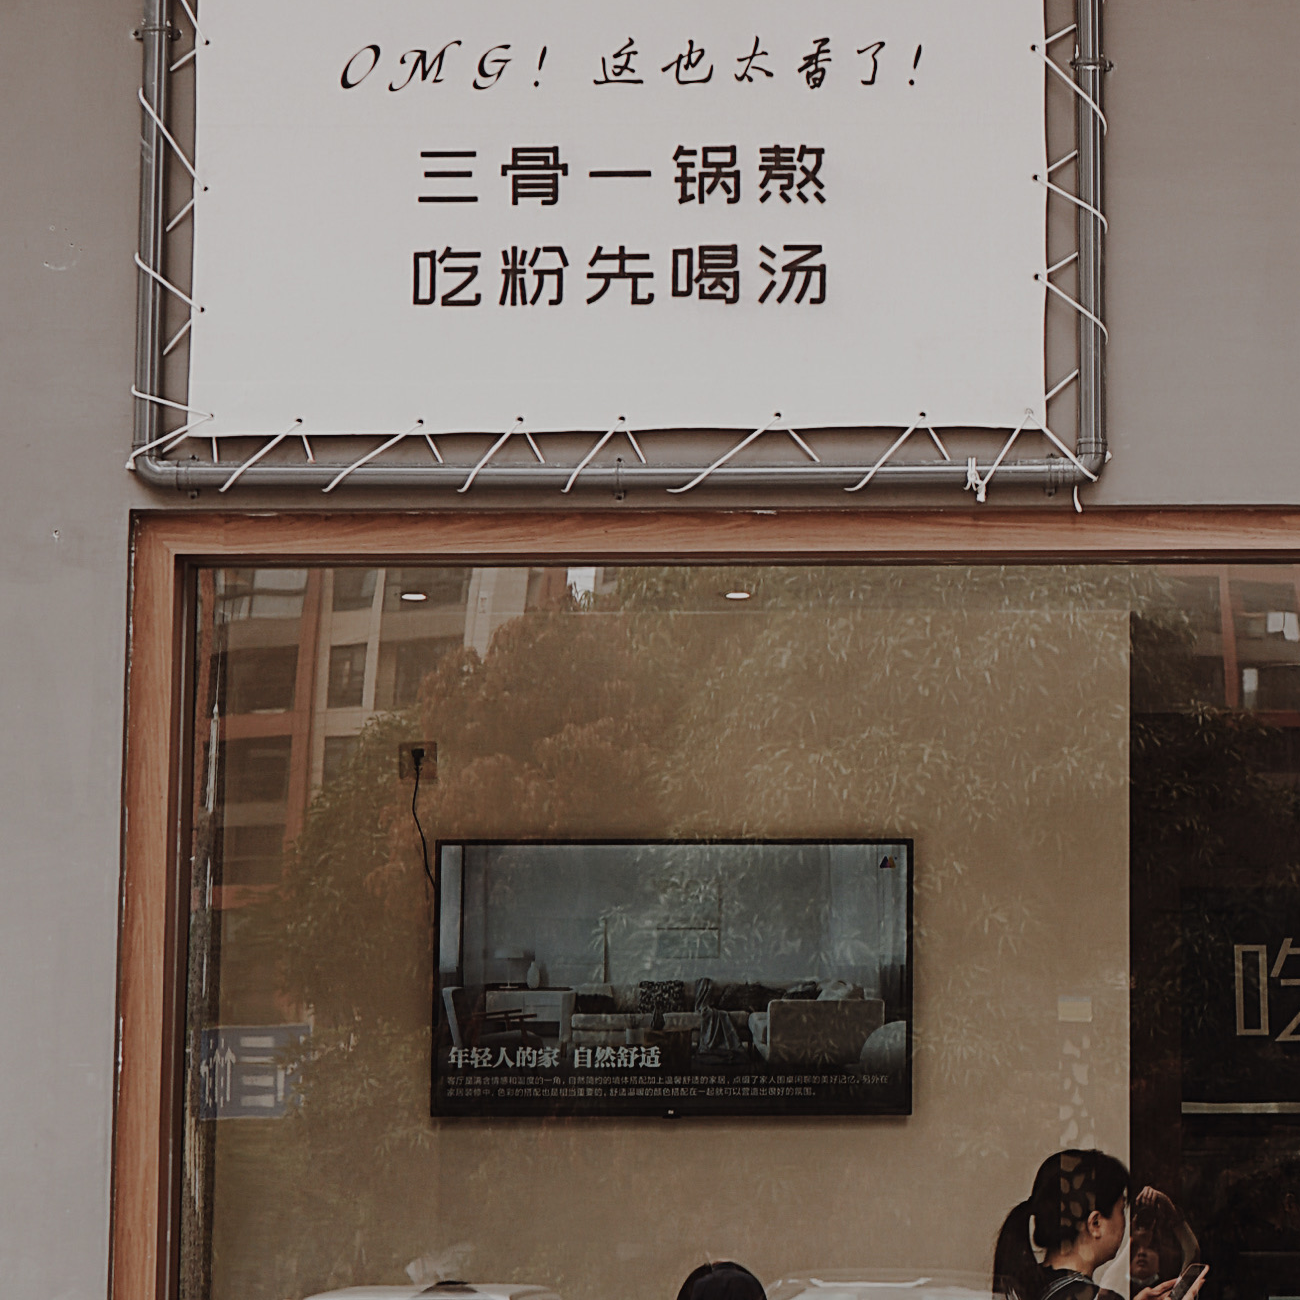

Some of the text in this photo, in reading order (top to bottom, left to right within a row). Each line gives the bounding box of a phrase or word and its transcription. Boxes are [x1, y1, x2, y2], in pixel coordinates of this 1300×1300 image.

[417, 144, 829, 207] 三骨一锅熬
[413, 244, 829, 308] 吃粉先喝汤
[447, 1045, 662, 1070] 年轻人的家 自然舒适
